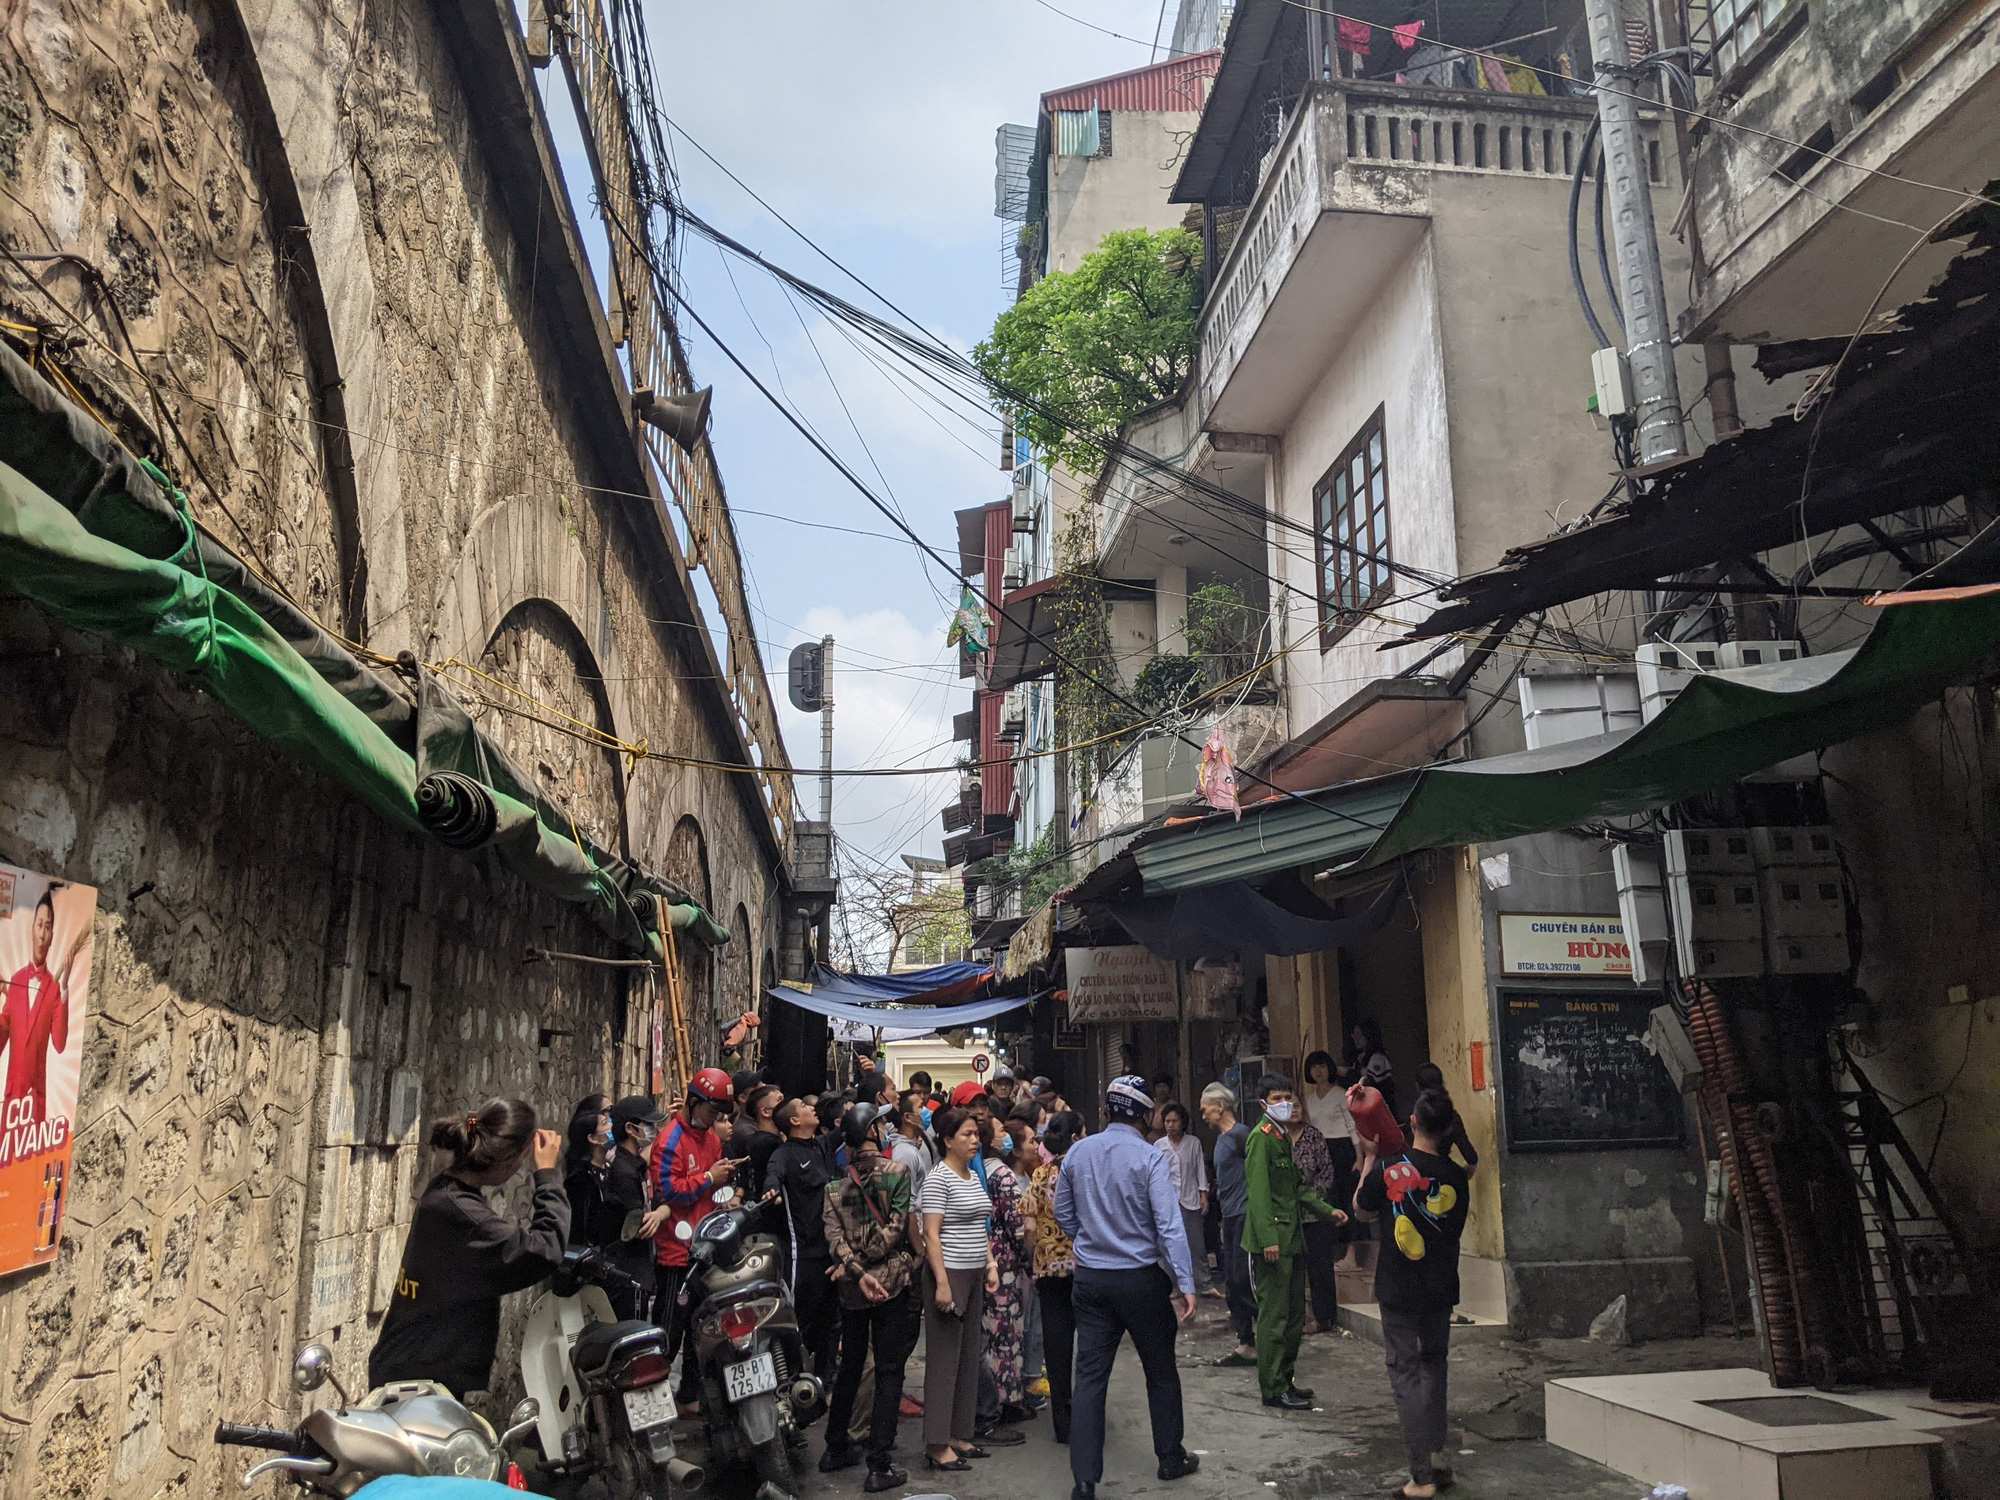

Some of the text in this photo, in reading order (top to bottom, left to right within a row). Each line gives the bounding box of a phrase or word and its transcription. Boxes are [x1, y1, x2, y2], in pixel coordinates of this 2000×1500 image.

[1531, 921, 1625, 935] CHUYÊN BÁN BU
[1600, 1002, 1620, 1012] TIN
[6, 1087, 34, 1130] CÓ
[13, 1116, 66, 1159] VÀNG
[398, 1278, 420, 1300] UT
[731, 1357, 766, 1382] 29-B1
